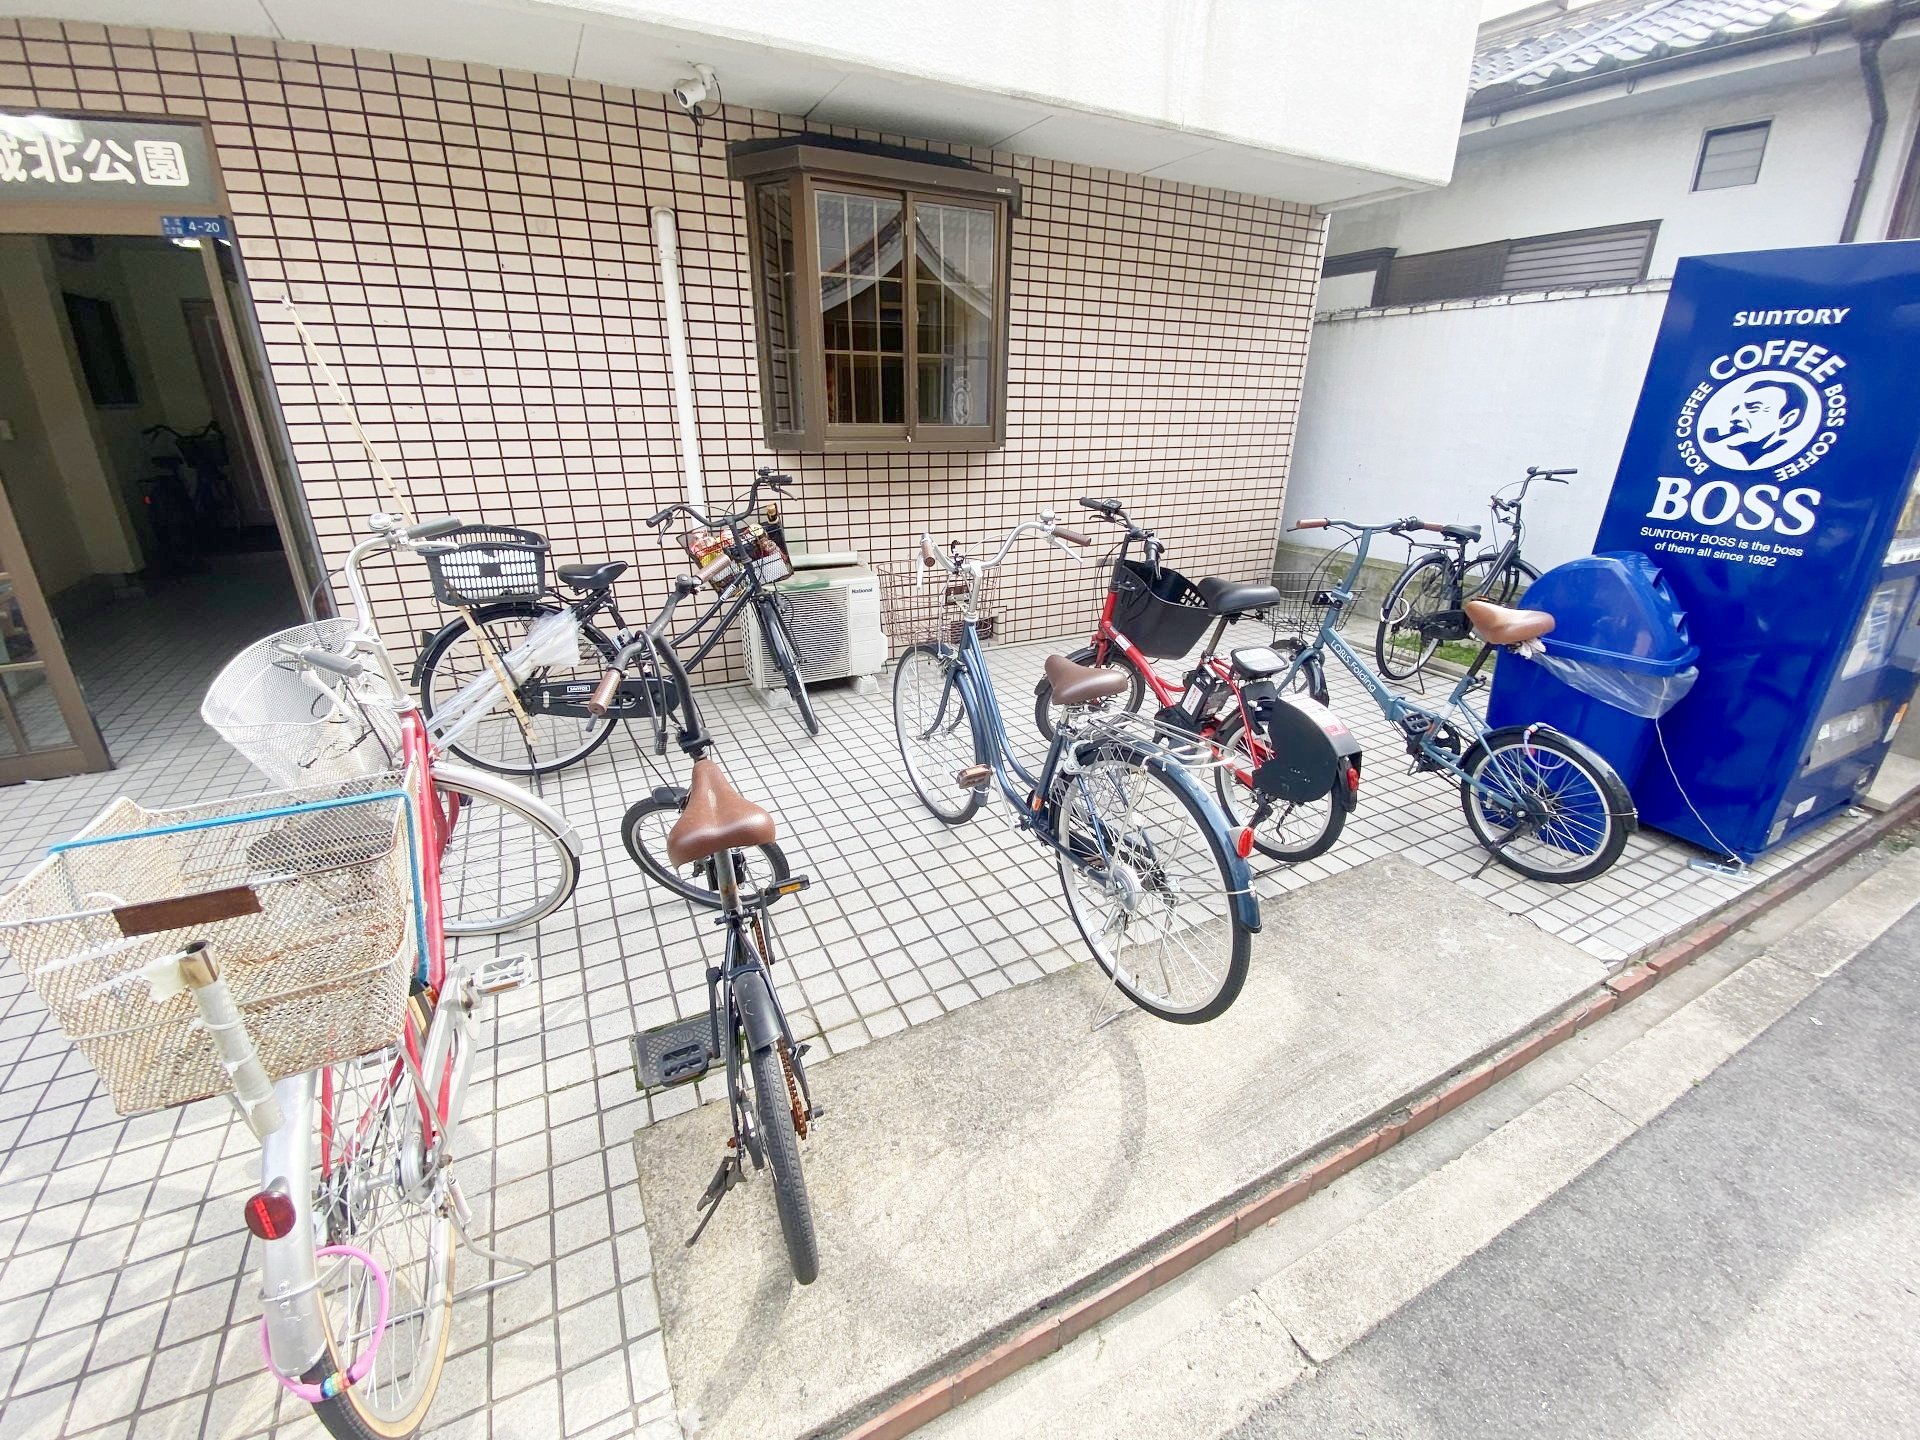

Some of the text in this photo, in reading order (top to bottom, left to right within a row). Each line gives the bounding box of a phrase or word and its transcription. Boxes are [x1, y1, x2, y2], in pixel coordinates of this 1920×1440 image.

[188, 221, 220, 233] 4-20
[1733, 308, 1850, 326] SUNTORY
[1709, 339, 1847, 384] COFFEE
[1675, 381, 1714, 476] BOSS COFFEE
[1773, 383, 1847, 482] BOSS COFFEE
[1645, 476, 1822, 536] BOSS
[1640, 526, 1804, 557] SUNTORY BOSS is the boss
[1654, 541, 1778, 567] of them all since 1992
[1330, 639, 1377, 693] LORIS Folding
